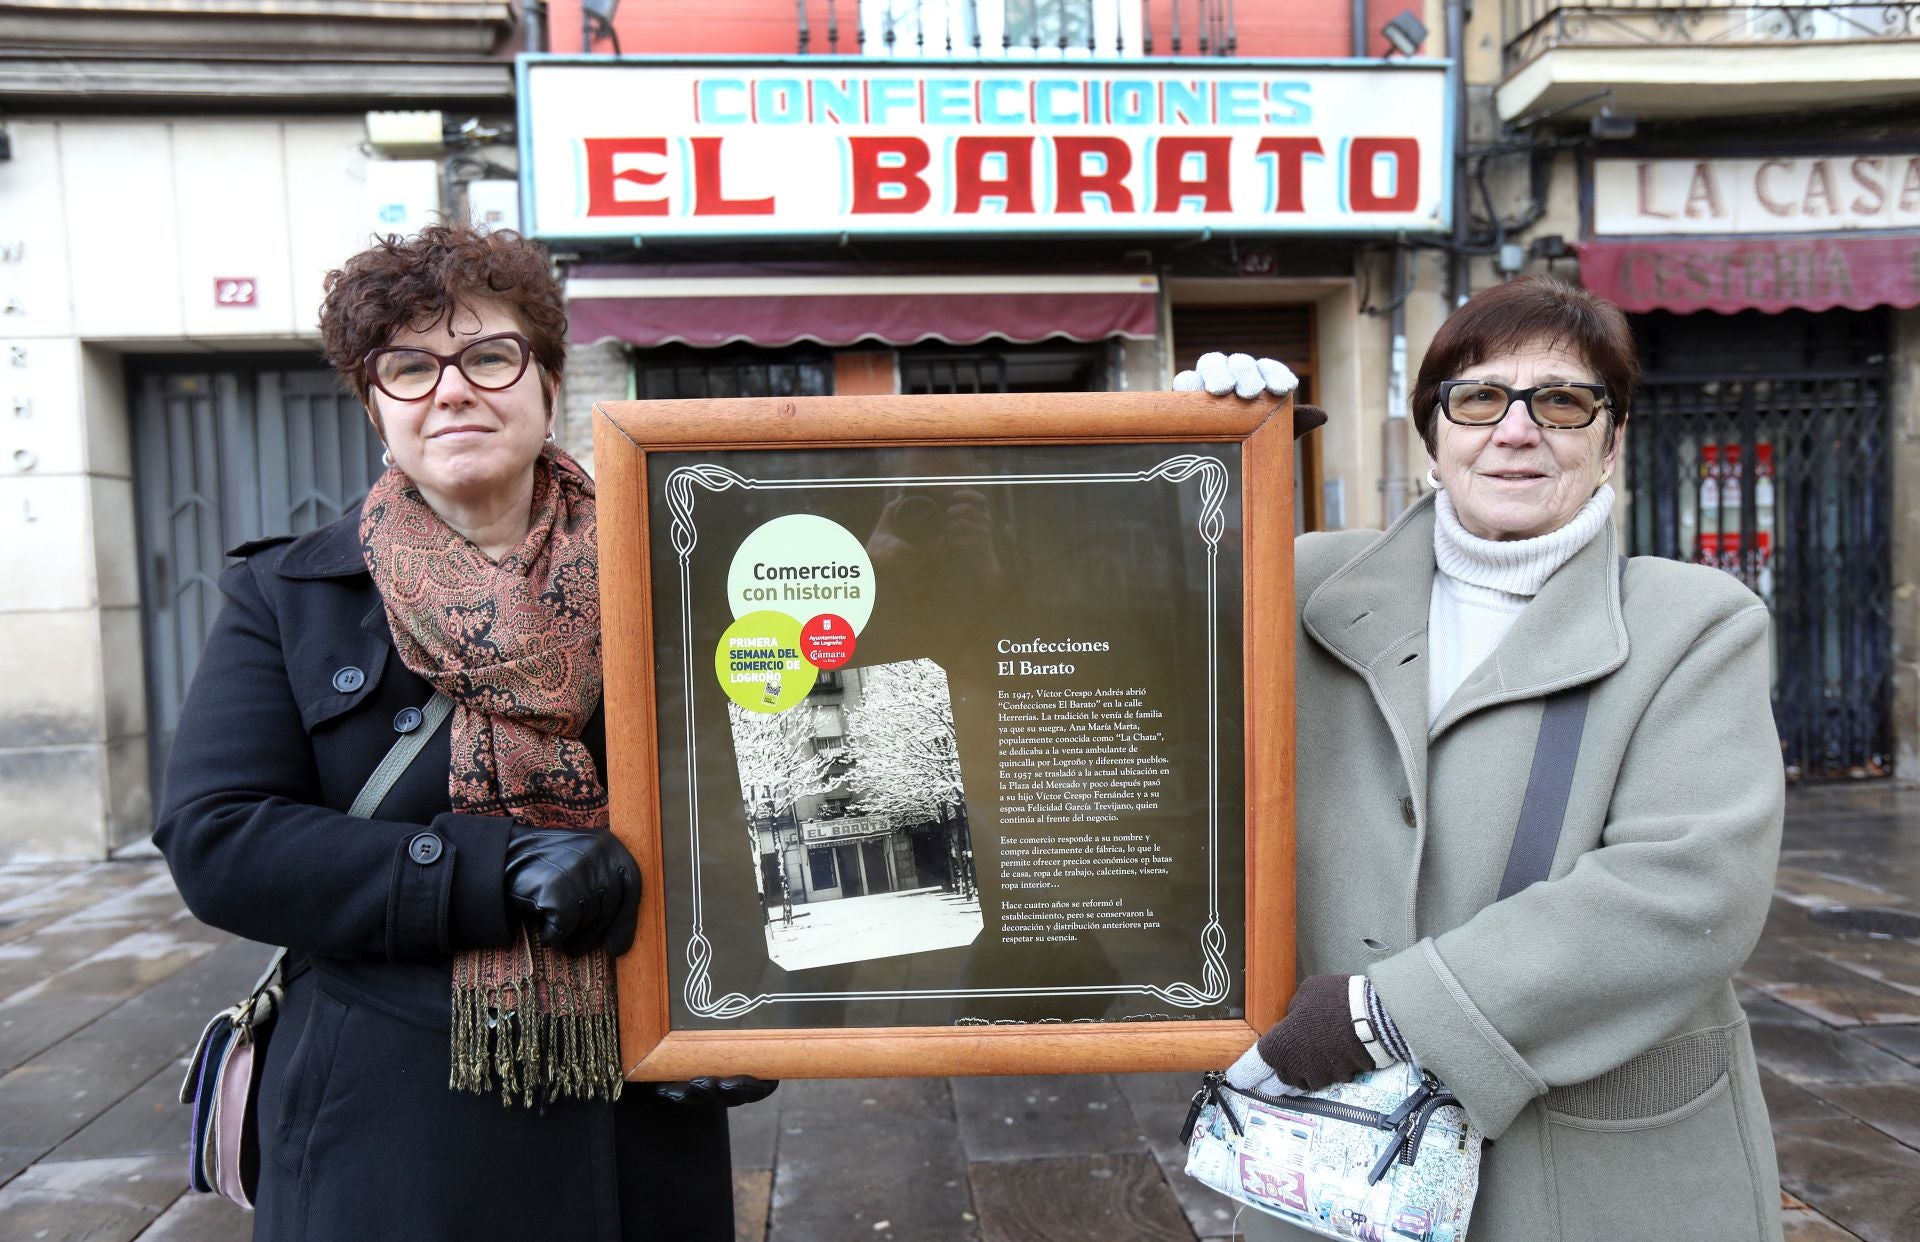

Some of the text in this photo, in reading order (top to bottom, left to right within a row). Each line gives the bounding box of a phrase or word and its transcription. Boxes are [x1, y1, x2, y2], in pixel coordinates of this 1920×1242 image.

[694, 80, 1312, 124] CONFECCIONES
[574, 135, 1421, 218] EL BARATO
[1636, 158, 1727, 219] LA
[219, 280, 254, 303] 22
[753, 562, 861, 581] Comercios
[743, 581, 861, 601] con historia
[729, 637, 778, 648] PRIMERA
[997, 639, 1109, 653] Confecciones
[729, 648, 798, 659] SEMANA DEL
[810, 650, 846, 660] Cámara
[730, 660, 800, 671] COMERCIO DE
[997, 661, 1074, 676] El Barato
[730, 670, 781, 683] LOGROÑO
[1036, 690, 1062, 698] Víctor
[1064, 689, 1092, 700] Crespo
[1094, 688, 1123, 696] Andrés
[1125, 688, 1146, 696] abrió
[998, 701, 1056, 710] “Confecciones
[1058, 700, 1067, 709] El
[1069, 700, 1100, 708] Barato”
[1114, 699, 1121, 708] la
[1124, 699, 1142, 707] calle
[998, 713, 1038, 721] Herrerías.
[1054, 712, 1089, 720] tradición
[1091, 711, 1098, 719] le
[1123, 710, 1133, 718] de
[1135, 710, 1162, 718] familia
[998, 727, 1007, 735] ya
[1009, 727, 1024, 735] que
[1038, 726, 1066, 734] suegra,
[1113, 723, 1142, 731] Marta,
[998, 736, 1054, 747] popularmente
[1055, 735, 1090, 743] conocida
[1115, 734, 1131, 742] “La
[1133, 733, 1164, 742] Chata”,
[1009, 747, 1043, 755] dedicaba
[1052, 746, 1059, 754] la
[1085, 745, 1126, 754] ambulante
[1128, 744, 1137, 753] de
[998, 758, 1035, 769] quincalla
[1037, 760, 1050, 768] por
[1052, 758, 1087, 768] Logroño
[1095, 757, 1134, 765] diferentes
[1136, 756, 1168, 766] pueblos.
[1012, 772, 1032, 780] 1957
[1044, 769, 1076, 777] trasladó
[1084, 768, 1091, 776] la
[1093, 768, 1117, 776] actual
[1119, 767, 1157, 776] ubicación
[999, 781, 1006, 790] la
[1008, 781, 1029, 789] Plaza
[1031, 780, 1043, 789] del
[1045, 780, 1080, 788] Mercado
[1089, 781, 1108, 790] poco
[1110, 779, 1140, 789] después
[1143, 778, 1160, 788] pasó
[1017, 792, 1033, 802] hijo
[1063, 792, 1091, 801] Crespo
[1093, 790, 1134, 799] Fernández
[999, 801, 1158, 815] esposa Felicidad García Trevijano, quien
[999, 813, 1118, 824] continúa al frente del negocio.
[807, 829, 827, 838] EL
[1019, 835, 1055, 844] comercio
[1057, 834, 1092, 845] responde
[1112, 833, 1143, 842] nombre
[1000, 844, 1160, 858] compra directamente de fábrica, lo que le
[1000, 859, 1030, 869] permite
[1032, 858, 1060, 866] ofrecer
[1062, 857, 1090, 867] precios
[1092, 856, 1138, 864] económicos
[1152, 855, 1172, 863] batas
[1000, 870, 1010, 878] de
[1033, 871, 1051, 879] ropa
[1052, 868, 1062, 877] de
[1064, 868, 1094, 878] trabajo,
[1096, 867, 1136, 876] calcetines,
[1139, 867, 1168, 876] viseras,
[1001, 880, 1059, 891] ropa interior...
[1082, 899, 1113, 907] reformó
[1115, 898, 1122, 907] el
[1001, 912, 1064, 920] establecimiento,
[1066, 913, 1084, 921] pero
[1146, 909, 1153, 917] la
[1001, 923, 1043, 931] decoración
[1053, 922, 1100, 930] distribución
[1102, 921, 1141, 929] anteriores
[1143, 922, 1160, 930] para
[1002, 936, 1033, 945] respetar
[1046, 933, 1077, 941] esencia.
